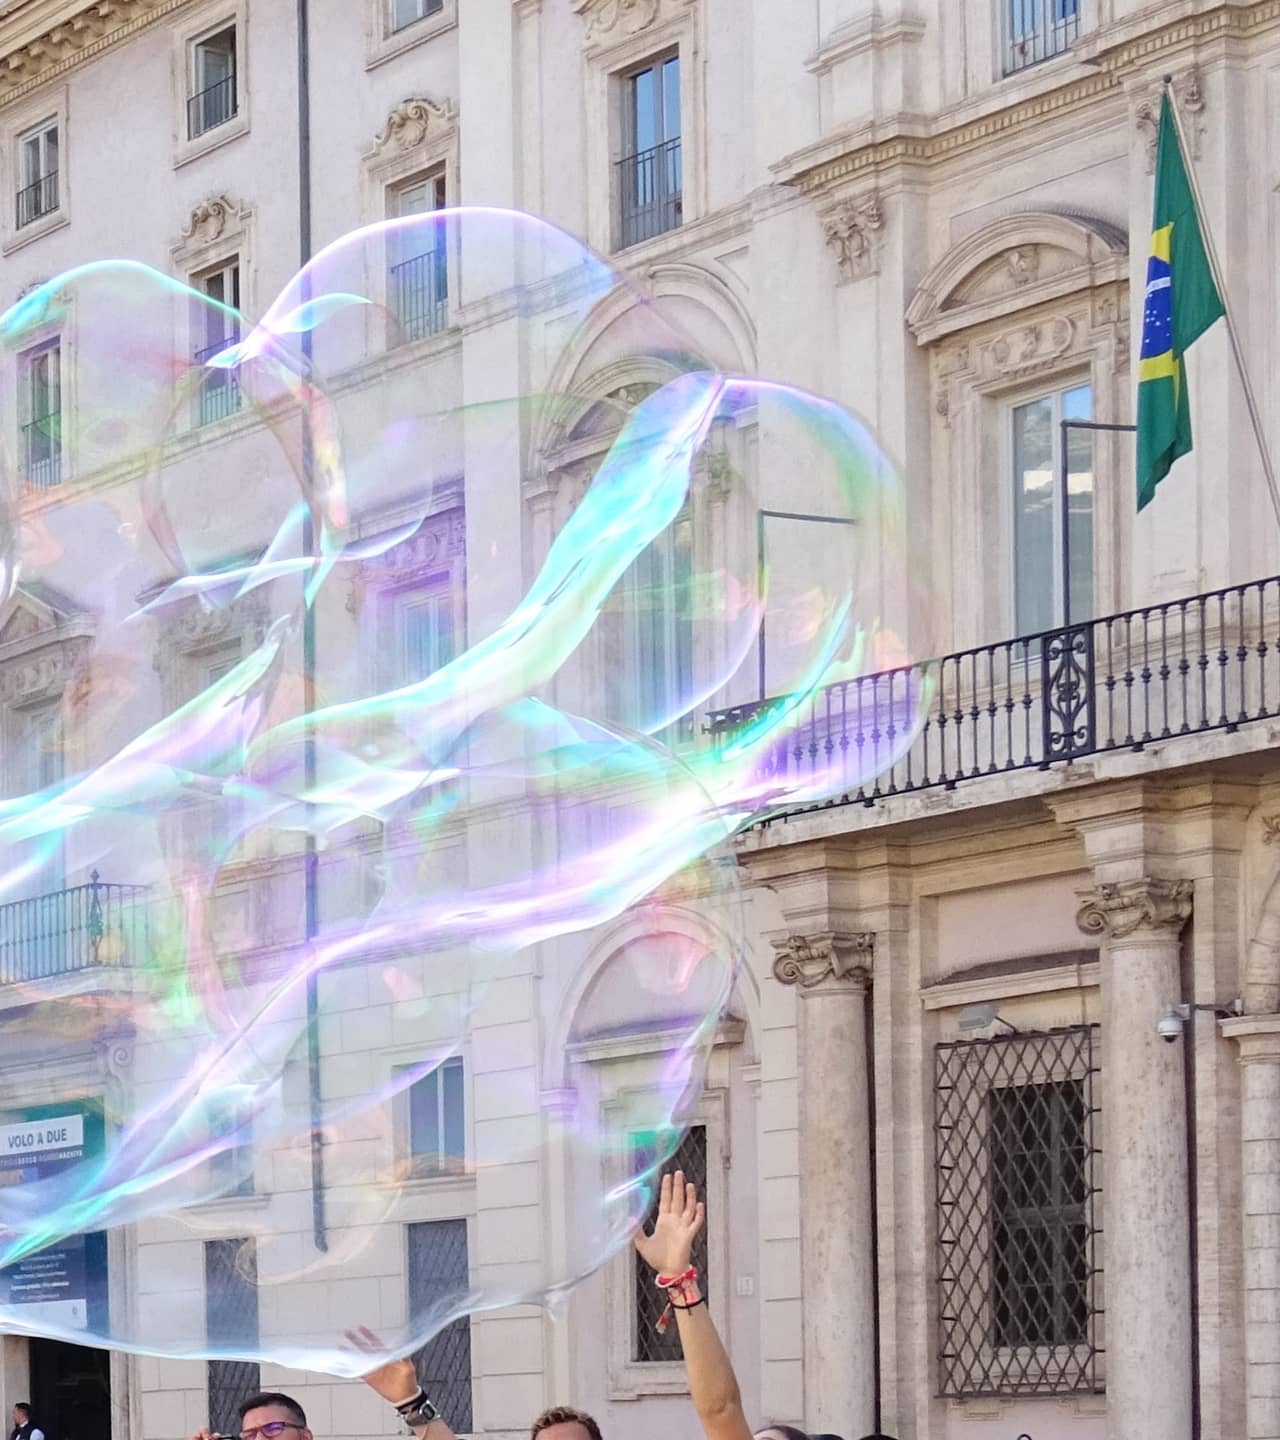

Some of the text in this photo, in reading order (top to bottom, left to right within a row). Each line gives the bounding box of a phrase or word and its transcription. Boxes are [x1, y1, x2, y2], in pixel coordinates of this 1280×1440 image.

[8, 1128, 67, 1148] VOLO A DUE
